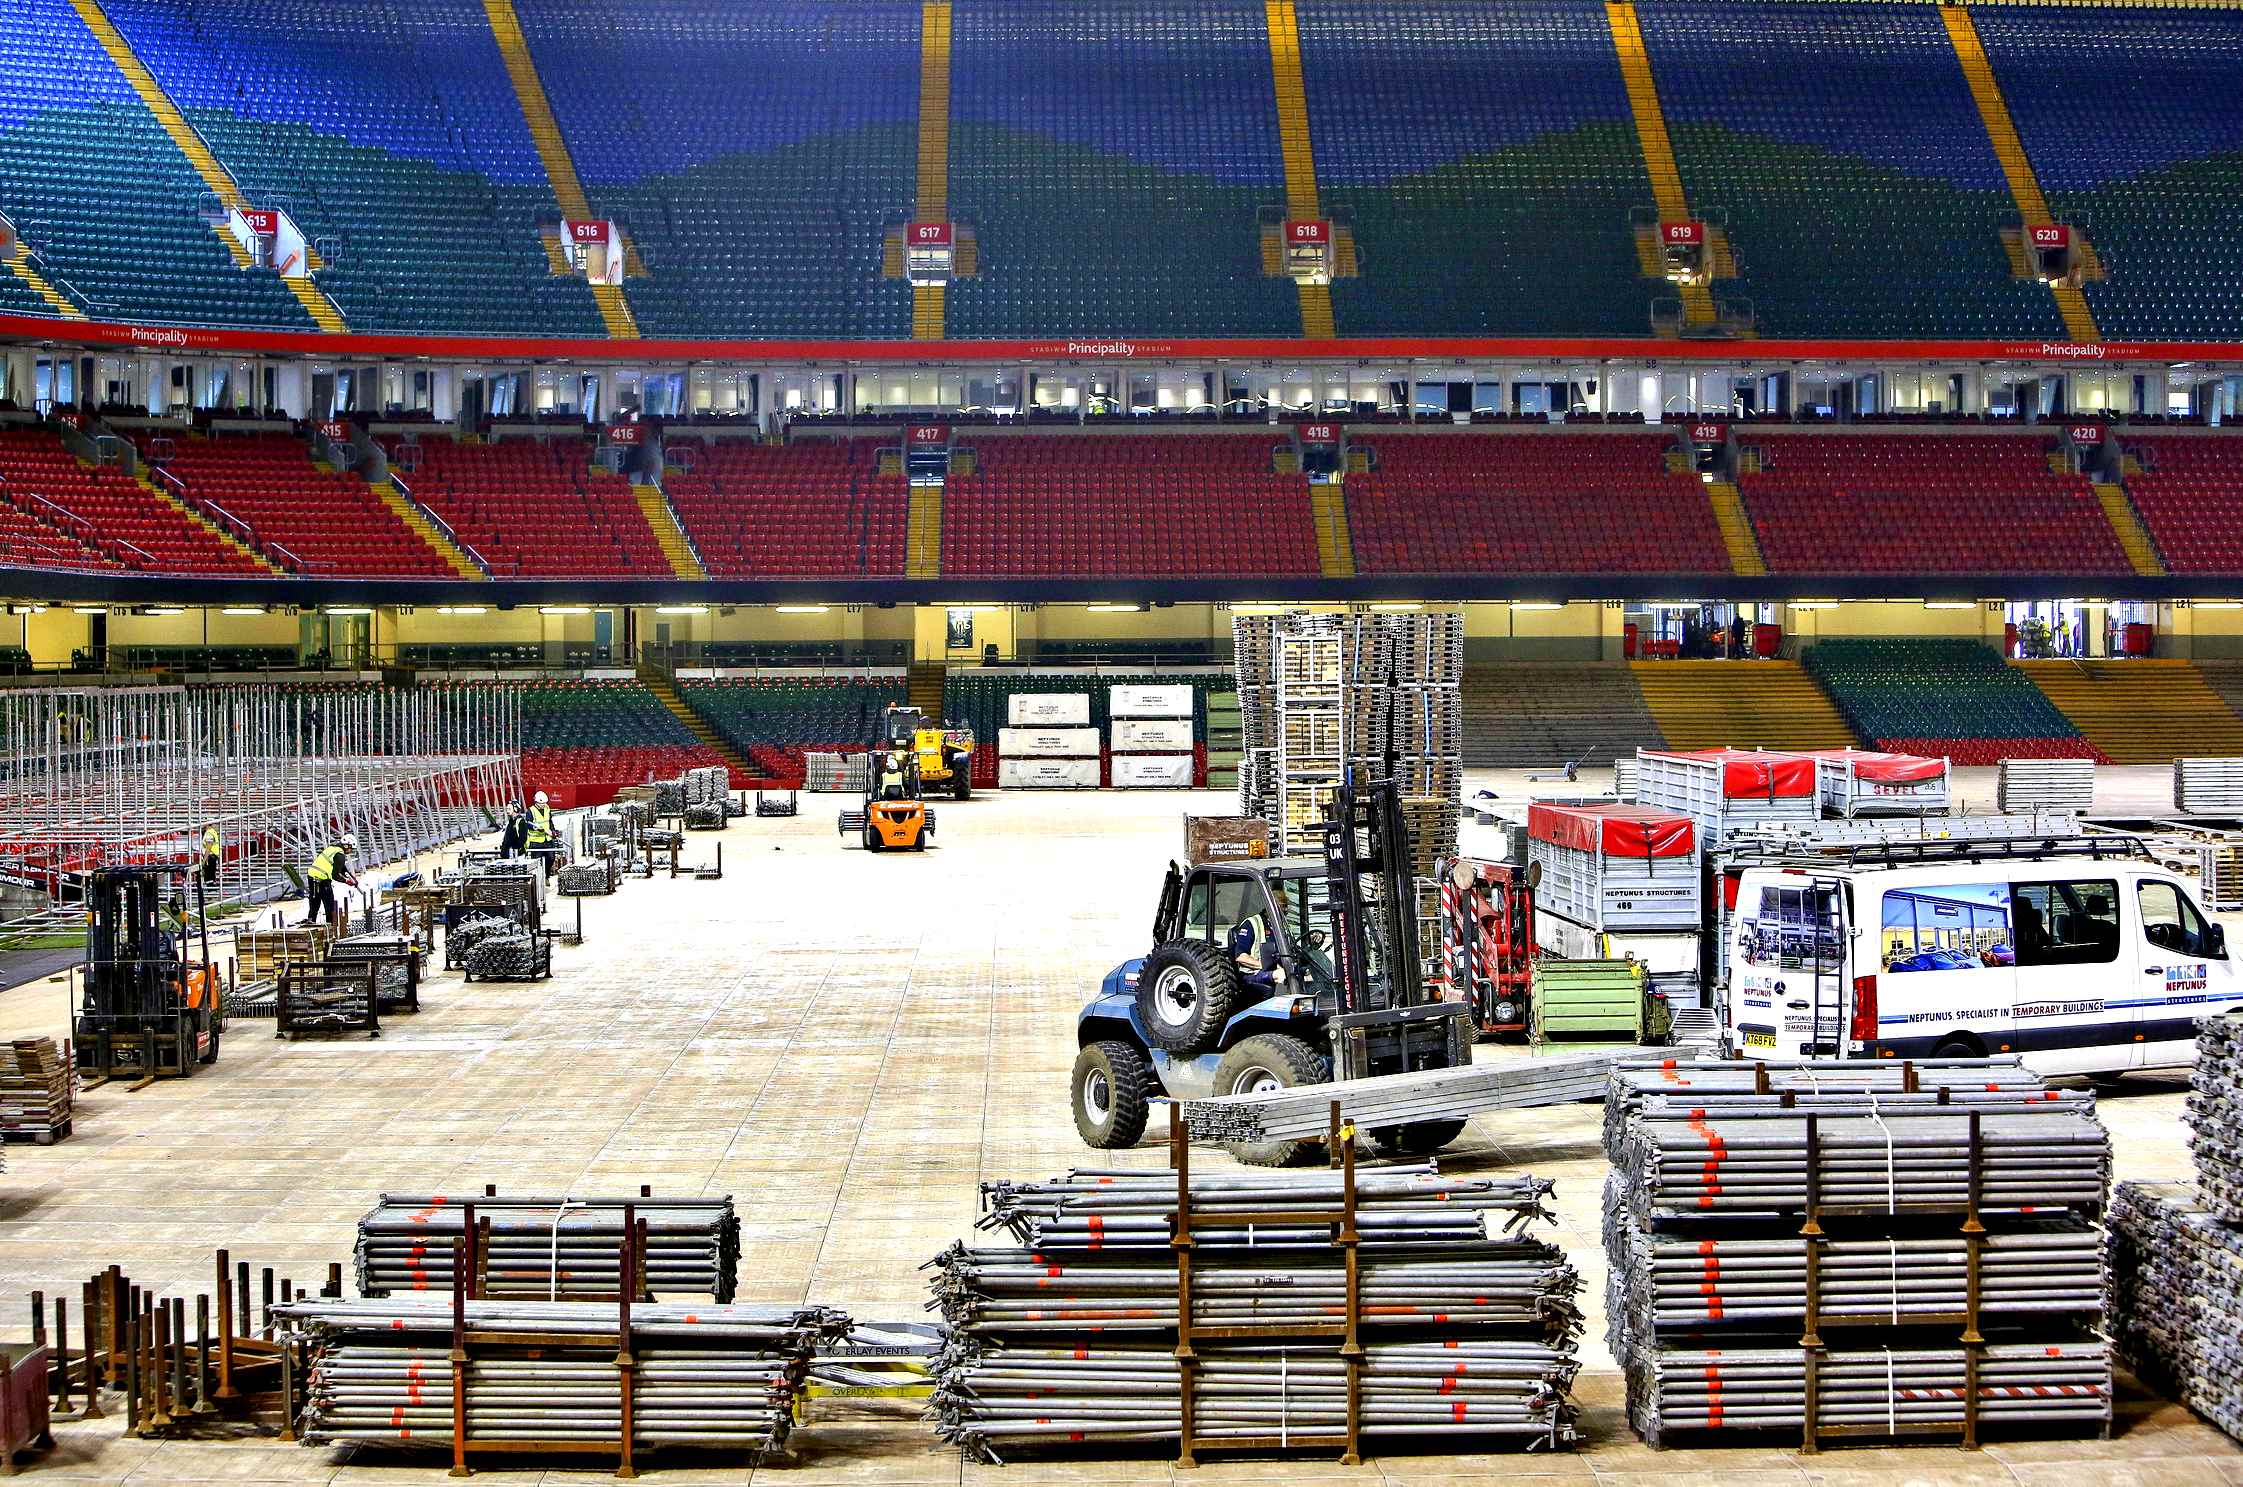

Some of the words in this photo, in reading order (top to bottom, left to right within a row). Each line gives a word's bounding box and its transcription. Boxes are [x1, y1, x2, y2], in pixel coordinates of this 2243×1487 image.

[247, 215, 267, 227] 615
[577, 225, 598, 237] 616
[919, 227, 940, 238] 617
[1296, 226, 1318, 237] 618
[1671, 227, 1692, 238] 619
[2036, 230, 2059, 241] 620
[131, 327, 188, 345] Principality
[1068, 341, 1135, 356] Principality
[2042, 344, 2106, 357] Principality
[321, 424, 341, 437] 415
[612, 428, 634, 439] 416
[916, 428, 938, 439] 417
[1307, 427, 1329, 438] 418
[1695, 426, 1718, 438] 419
[2072, 427, 2097, 439] 420
[1329, 833, 1341, 845] 03
[1329, 848, 1343, 860] UK
[1646, 889, 1692, 897] STRUCTURES
[1616, 901, 1632, 909] 469
[2166, 980, 2207, 992] NEPTUNUS
[1744, 988, 1772, 998] NEPTUNUS
[1956, 1009, 1998, 1020] SPECIALIST
[2000, 1008, 2010, 1017] IN
[2012, 1005, 2061, 1016] TEMPORARY
[2062, 1001, 2104, 1013] BUILDINGS
[875, 1346, 910, 1356] EVENTS
